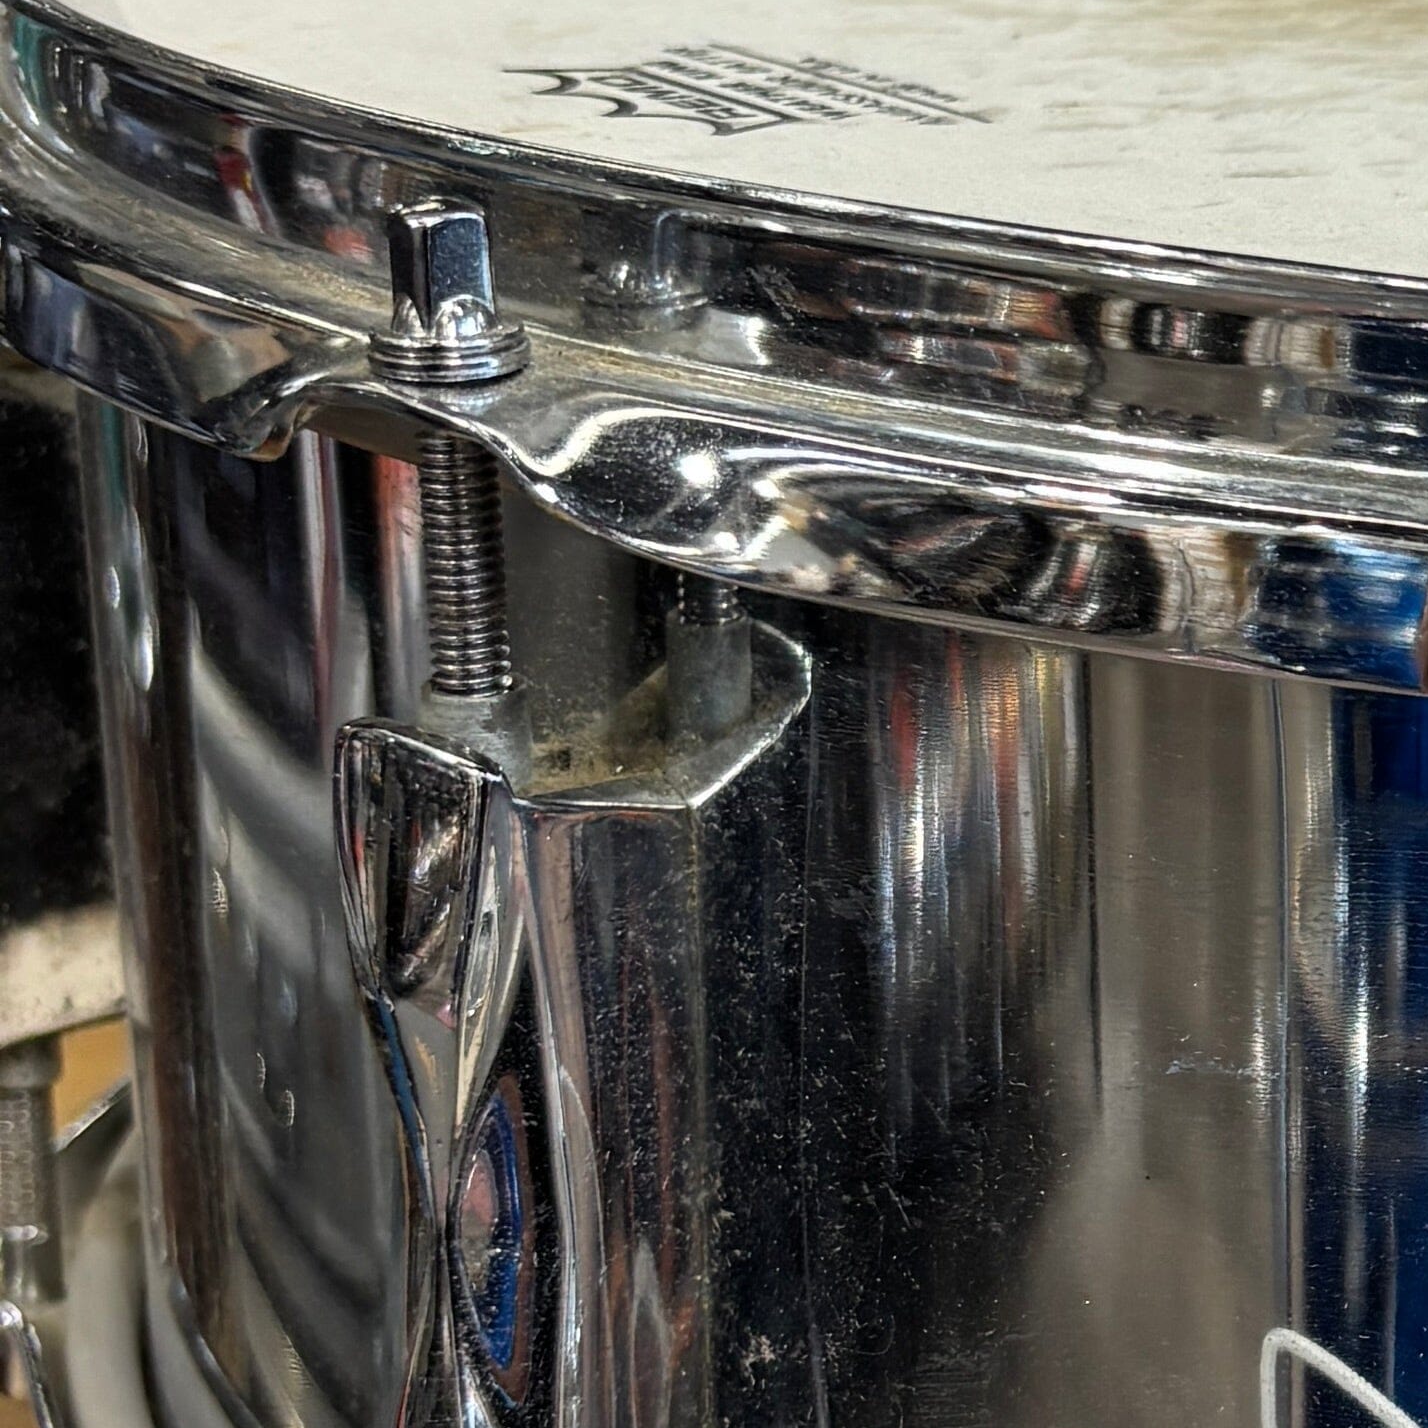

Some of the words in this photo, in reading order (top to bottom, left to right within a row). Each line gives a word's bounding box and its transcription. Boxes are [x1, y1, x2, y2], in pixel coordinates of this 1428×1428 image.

[642, 61, 724, 82] KING
[586, 75, 758, 121] REMO
[717, 82, 858, 121] WEATHER
